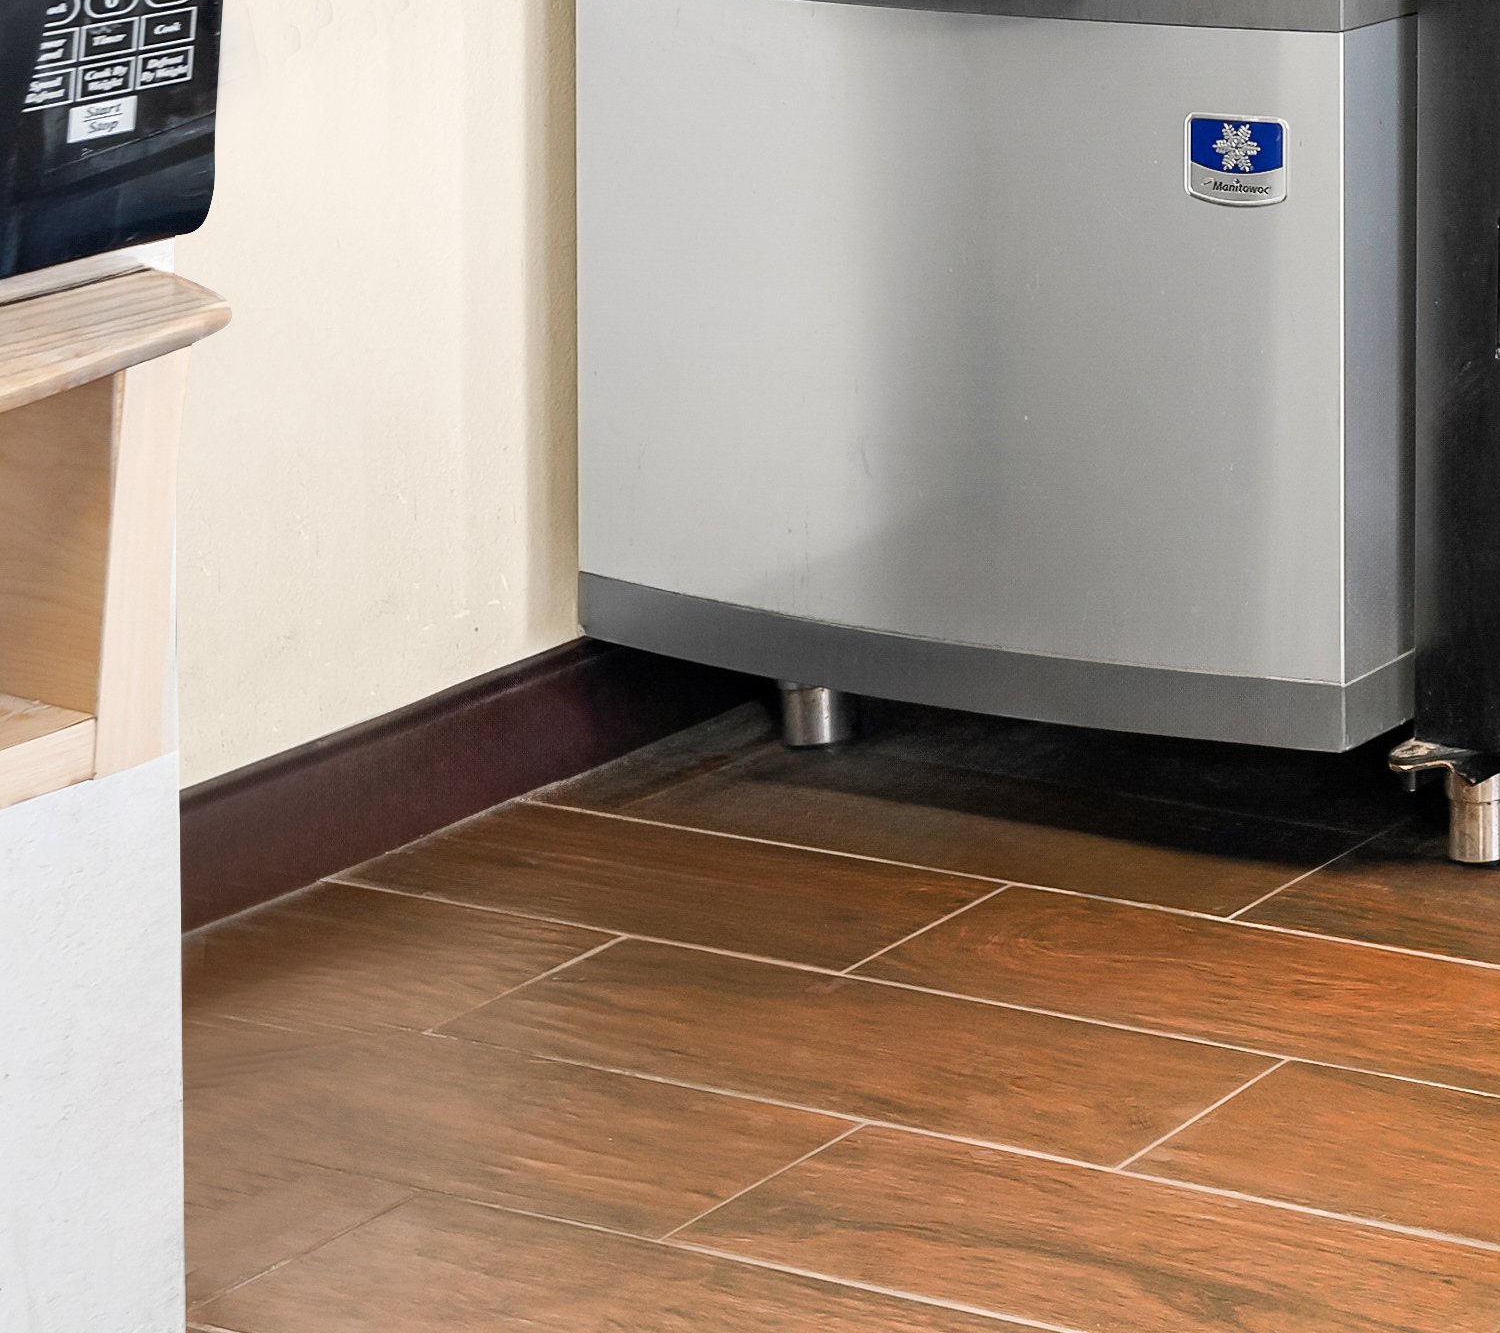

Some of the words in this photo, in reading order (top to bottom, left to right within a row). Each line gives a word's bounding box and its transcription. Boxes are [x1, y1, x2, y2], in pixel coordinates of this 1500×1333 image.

[85, 102, 122, 119] Start
[88, 119, 119, 133] Stop
[1212, 179, 1270, 194] Manitowoc
